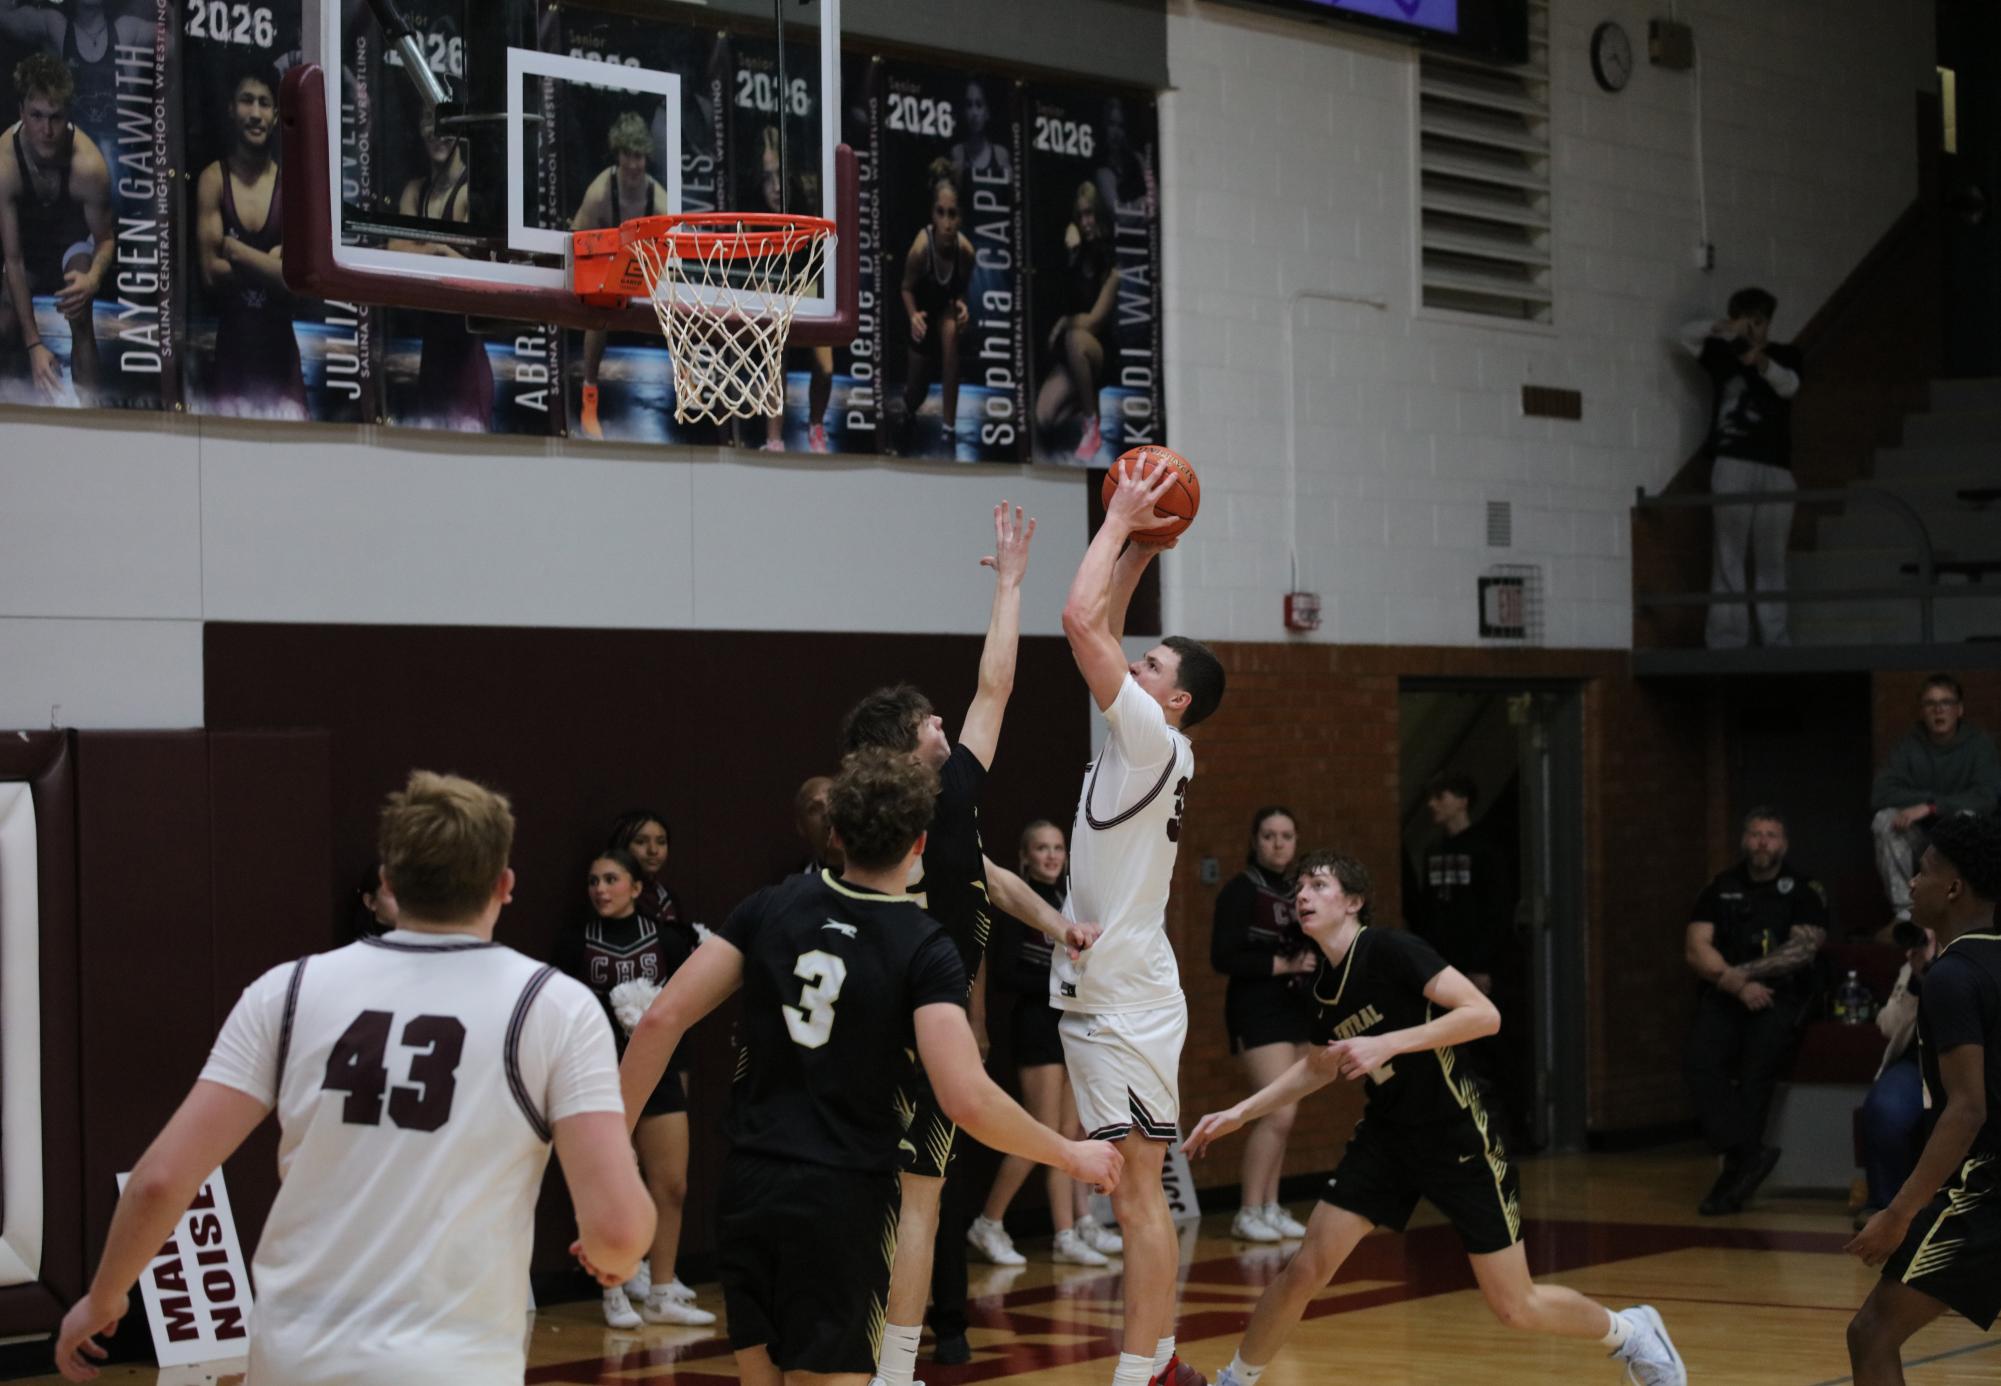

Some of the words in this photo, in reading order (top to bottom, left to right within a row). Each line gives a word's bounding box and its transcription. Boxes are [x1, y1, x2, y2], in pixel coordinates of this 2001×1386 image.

[186, 0, 276, 48] 2026
[115, 44, 155, 200] GAWITH
[357, 36, 369, 125] WRESTLING
[886, 92, 956, 139] 2026
[155, 97, 168, 166] SCHOOL
[358, 131, 370, 197] SCHOOL
[1033, 115, 1096, 158] 2026
[157, 171, 169, 214] HIGH
[973, 167, 1012, 270] CAPE
[117, 218, 162, 373] DAYGEN
[158, 221, 171, 292] CENTRAL
[1114, 199, 1151, 326] WAITE
[160, 298, 172, 356] SALINA
[359, 321, 371, 378] SALINA
[515, 325, 549, 412] ABR
[548, 341, 560, 396] SALINA
[978, 290, 1016, 446] Sophia
[1119, 348, 1153, 444] KODI
[782, 949, 847, 1049] 3
[321, 1009, 467, 1132] 43
[153, 1230, 200, 1343] MA
